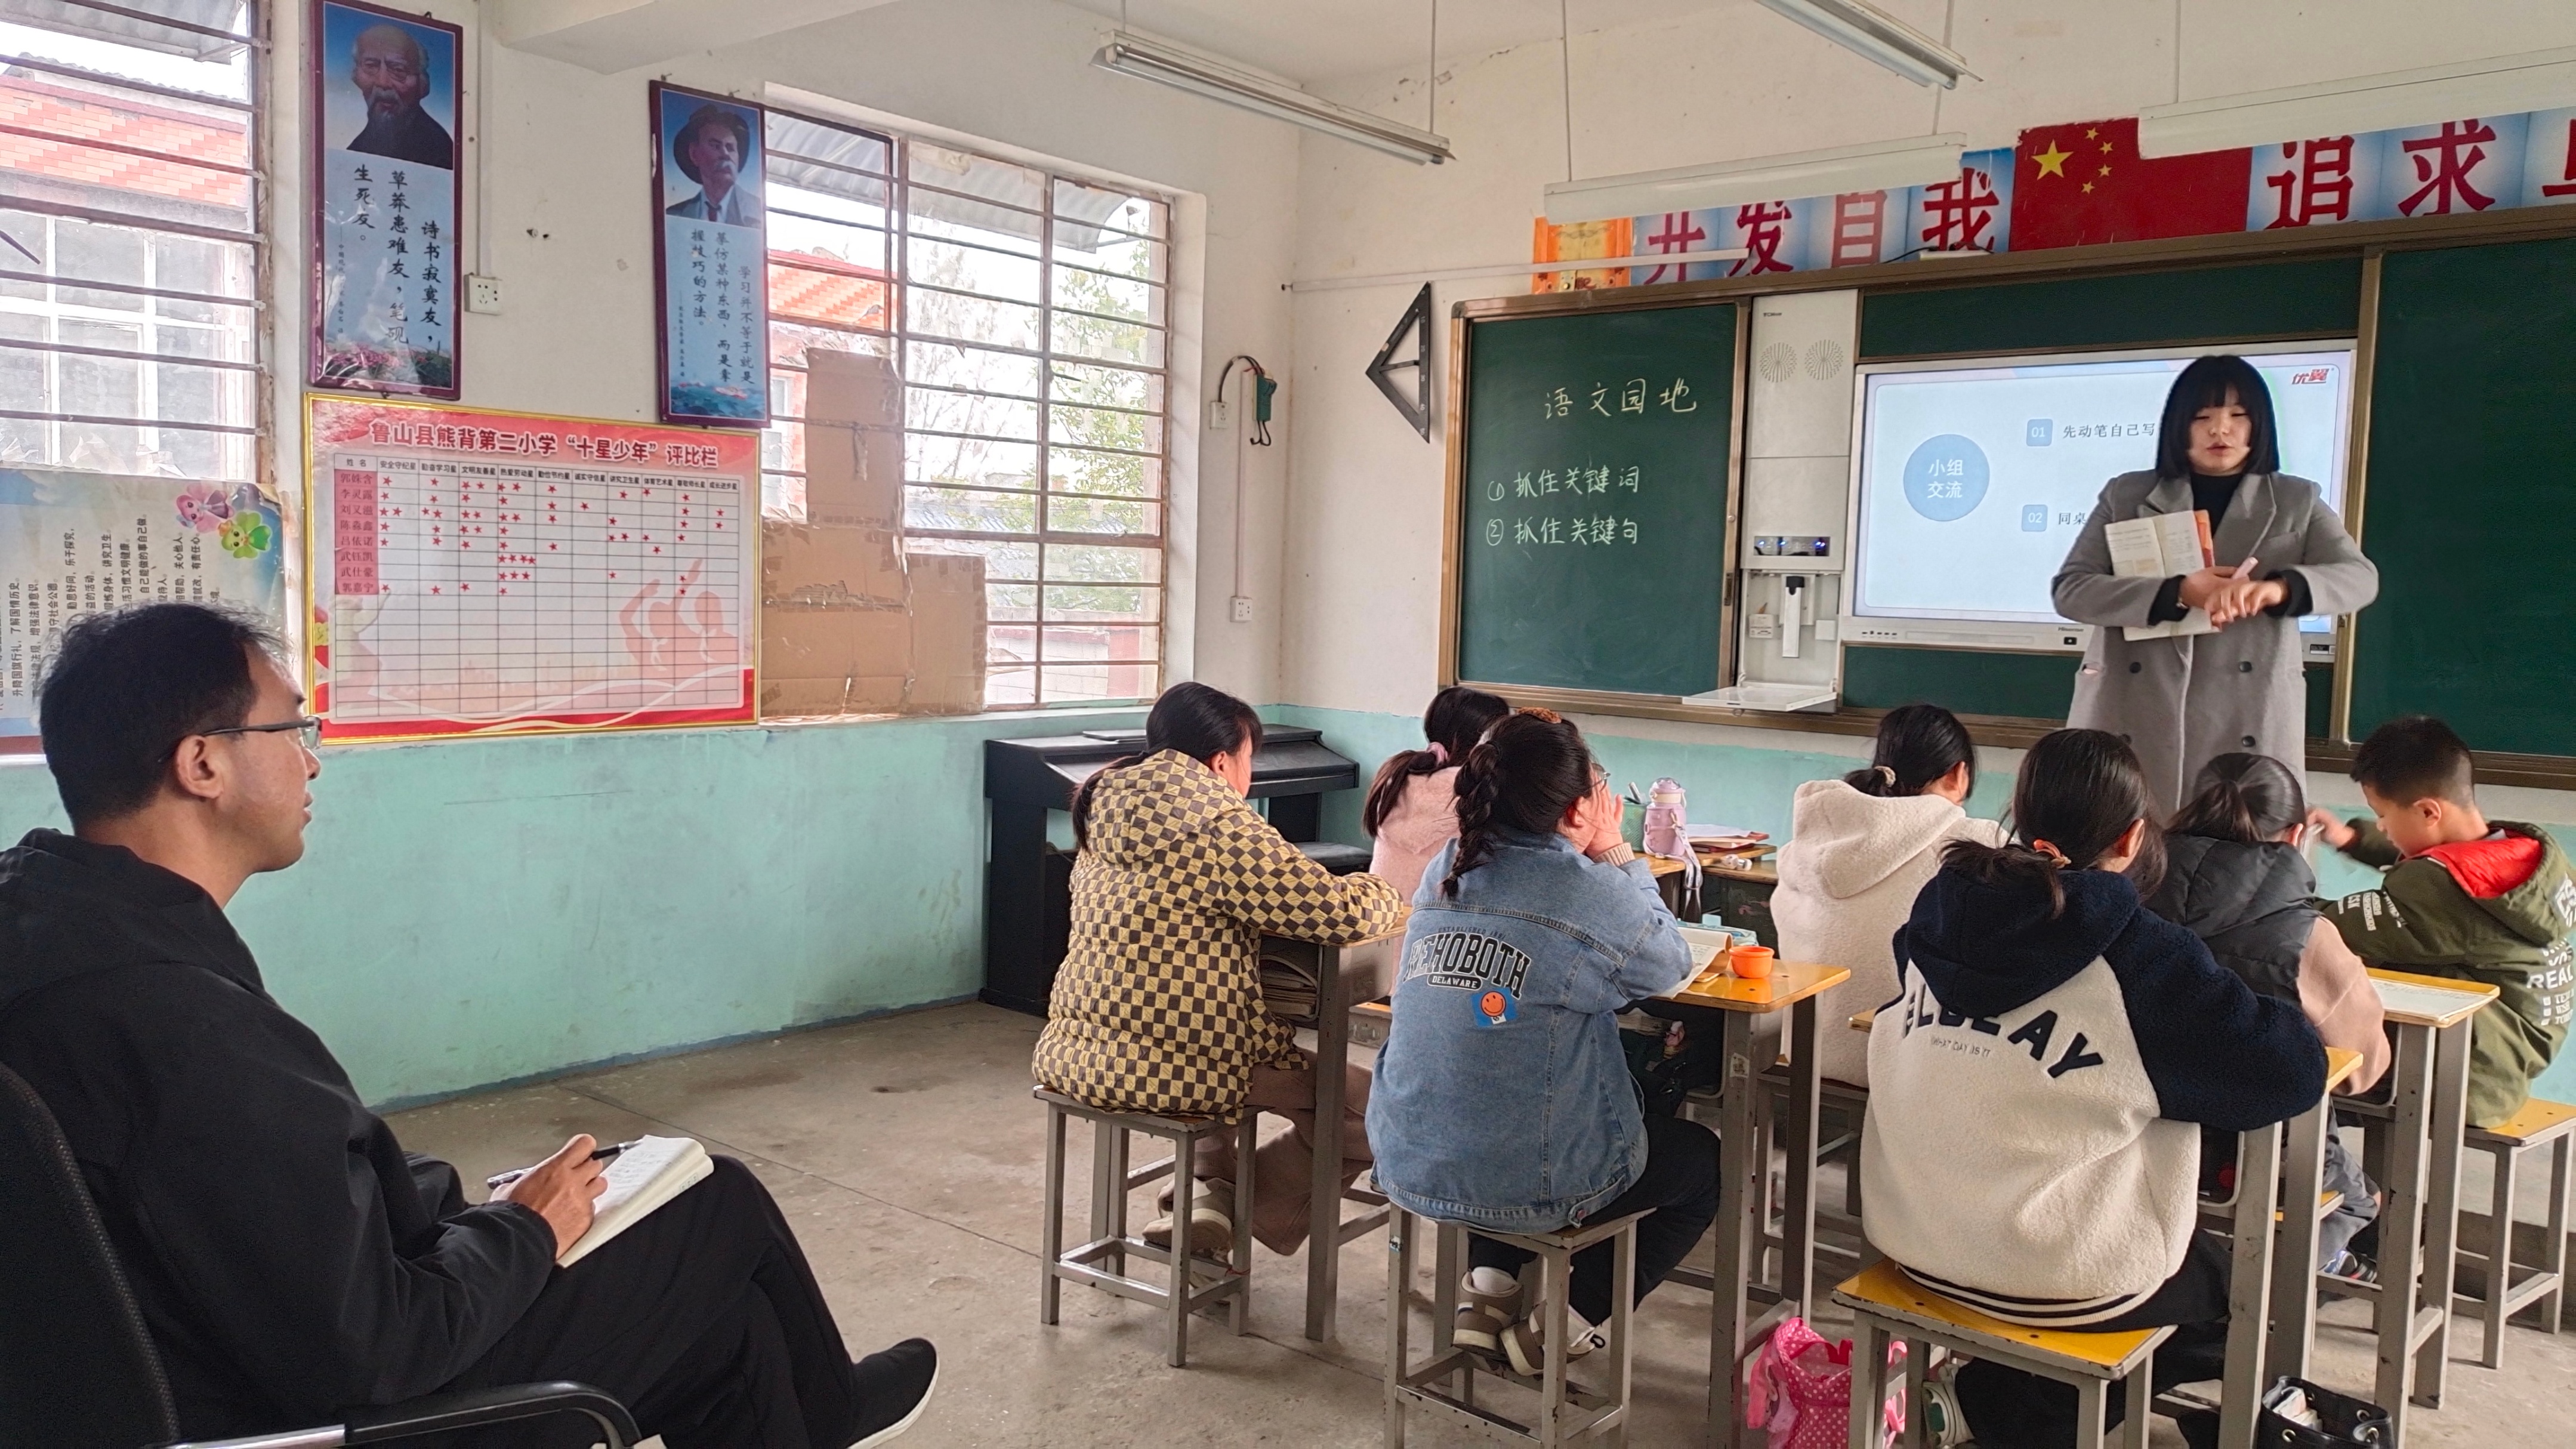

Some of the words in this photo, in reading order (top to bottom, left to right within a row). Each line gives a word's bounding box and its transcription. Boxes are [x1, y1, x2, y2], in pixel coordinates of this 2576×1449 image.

[352, 164, 375, 241] 生死友。
[387, 170, 411, 344] 草莽患难友，笔砚
[421, 220, 442, 343] 诗书寂寞友，
[690, 229, 708, 326] 握技巧的方法。
[738, 266, 755, 384] 学习并不等于就是
[1544, 378, 1696, 420] 语文园地
[2031, 427, 2046, 437] 01
[2063, 423, 2155, 439] 先动笔自己写
[1514, 464, 1639, 498] 抓住关键词
[1928, 459, 1964, 477] 小组
[1927, 480, 1963, 498] 交流
[1514, 514, 1637, 545] 抓住关键句
[2028, 512, 2043, 523] 02
[2058, 512, 2087, 525] 同桌
[137, 514, 150, 593] 自己能做的事自己做。
[1403, 932, 1532, 1000] REHOBOTH
[1432, 976, 1477, 988] DELAWARE
[1953, 1042, 1967, 1052] DAY
[1972, 1046, 1980, 1055] IS
